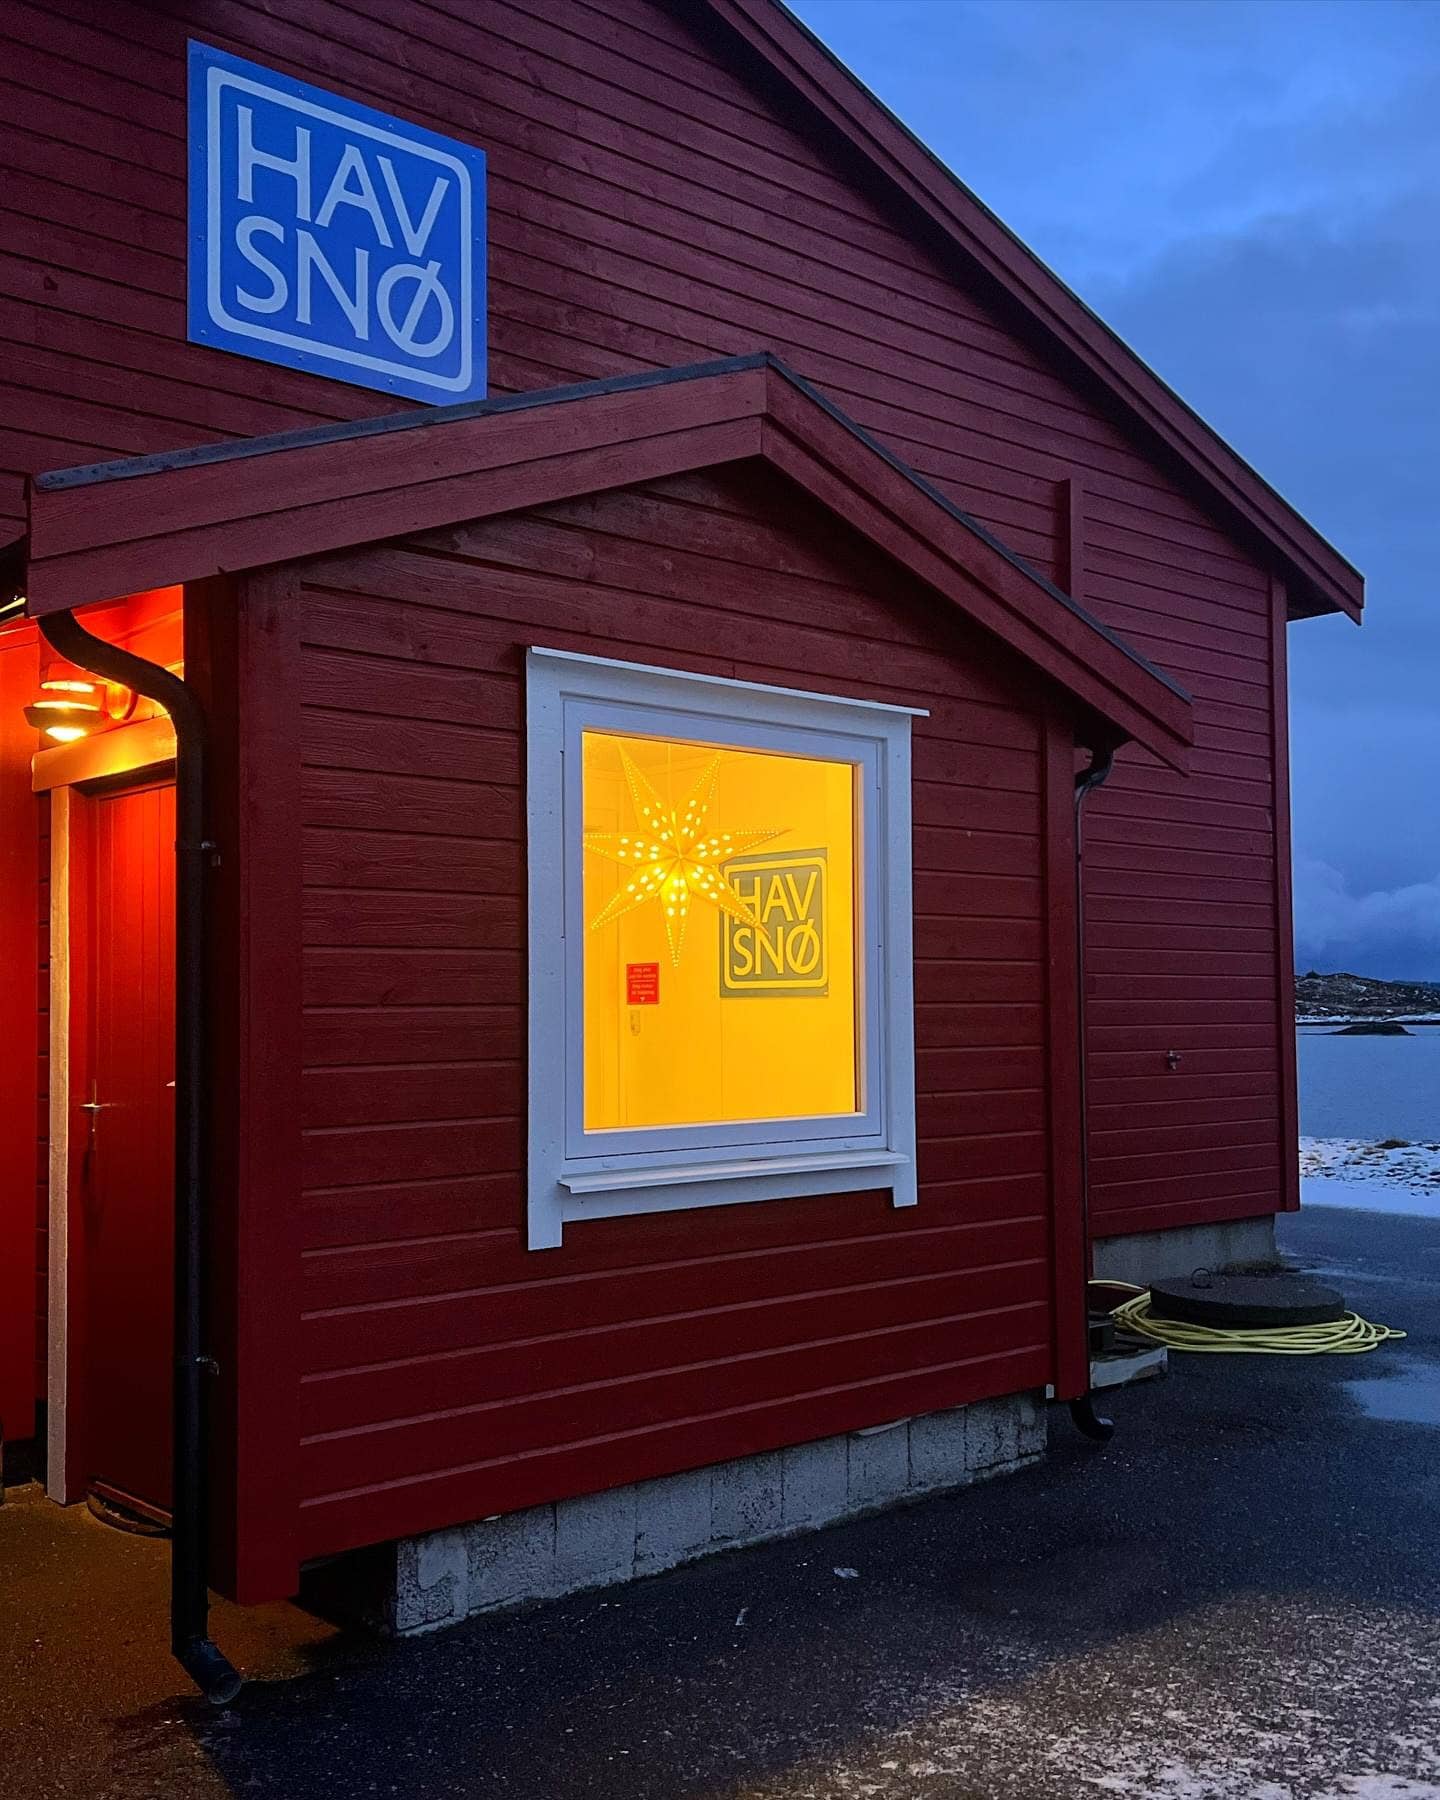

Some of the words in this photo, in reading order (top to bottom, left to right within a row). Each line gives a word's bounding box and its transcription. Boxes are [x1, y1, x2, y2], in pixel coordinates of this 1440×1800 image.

[237, 104, 449, 257] HAV
[235, 215, 454, 358] SNØ
[733, 871, 818, 925] HAV
[733, 919, 820, 976] SNØ
